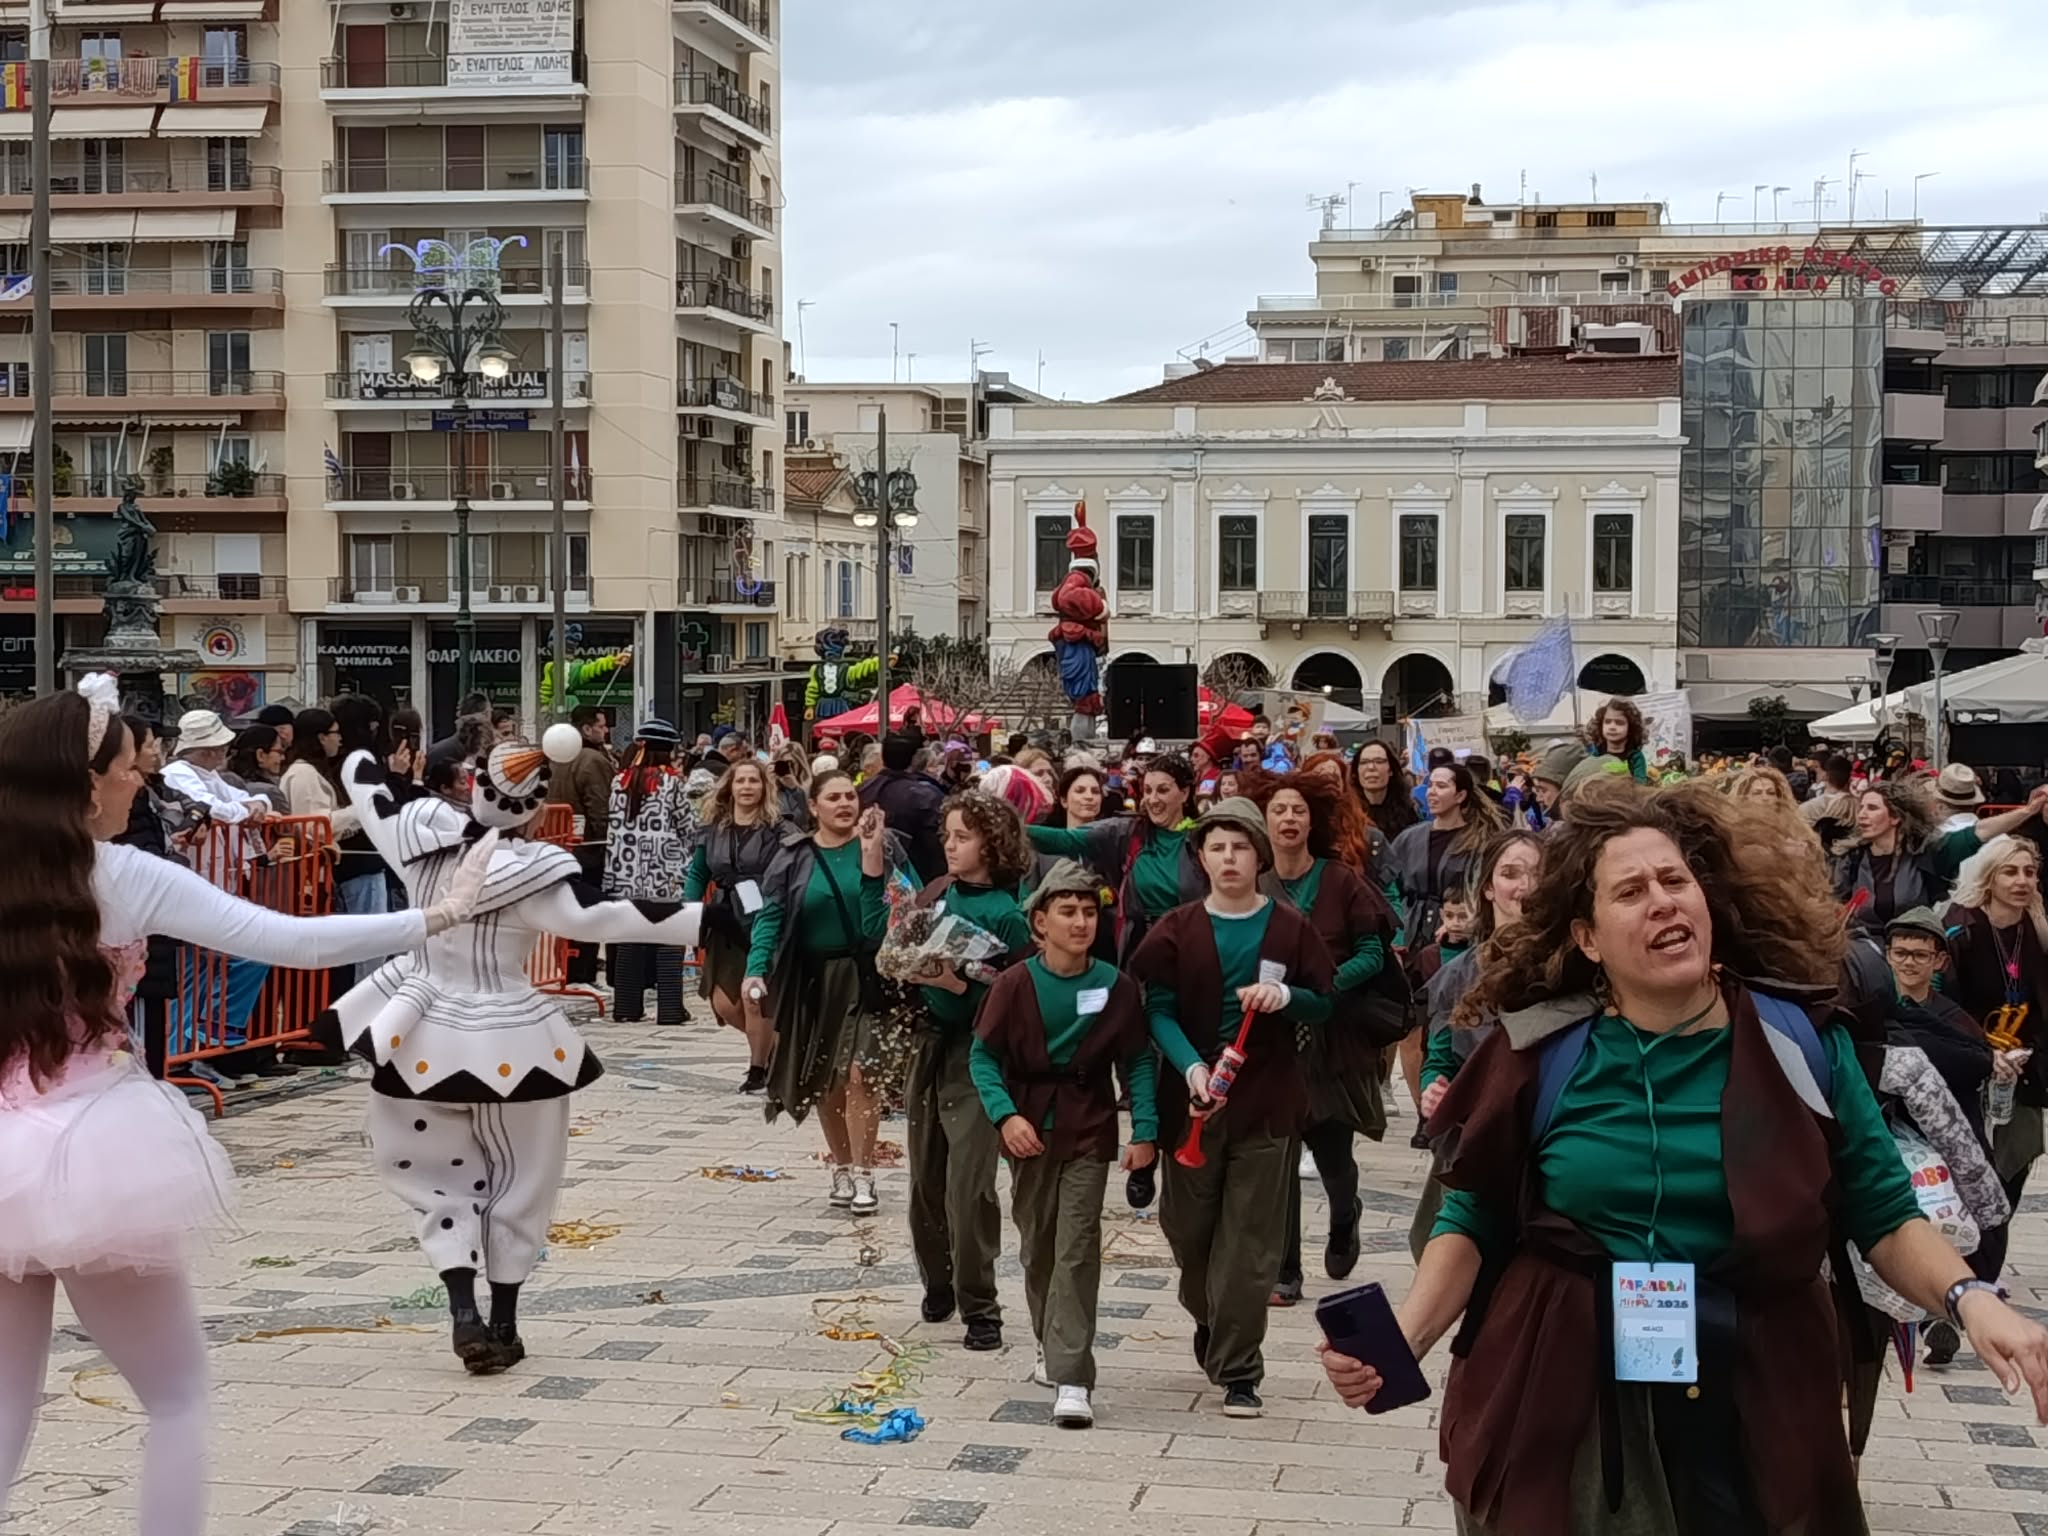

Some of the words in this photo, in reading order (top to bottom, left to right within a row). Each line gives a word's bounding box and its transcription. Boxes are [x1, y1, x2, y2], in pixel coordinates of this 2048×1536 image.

[471, 2, 529, 15] ΕΥΑΓΓΕΛΟΣ
[467, 57, 525, 72] ΕΥΑΓΓΕΛΟΣ
[534, 56, 569, 70] ΛΩΛΗΣ
[360, 372, 441, 388] MASSAGE
[483, 371, 545, 387] RITUAL
[318, 645, 410, 655] ΚΑΛΛΥΝΤΙΚΑ
[335, 656, 393, 667] ΧΗΜΙΚΑ
